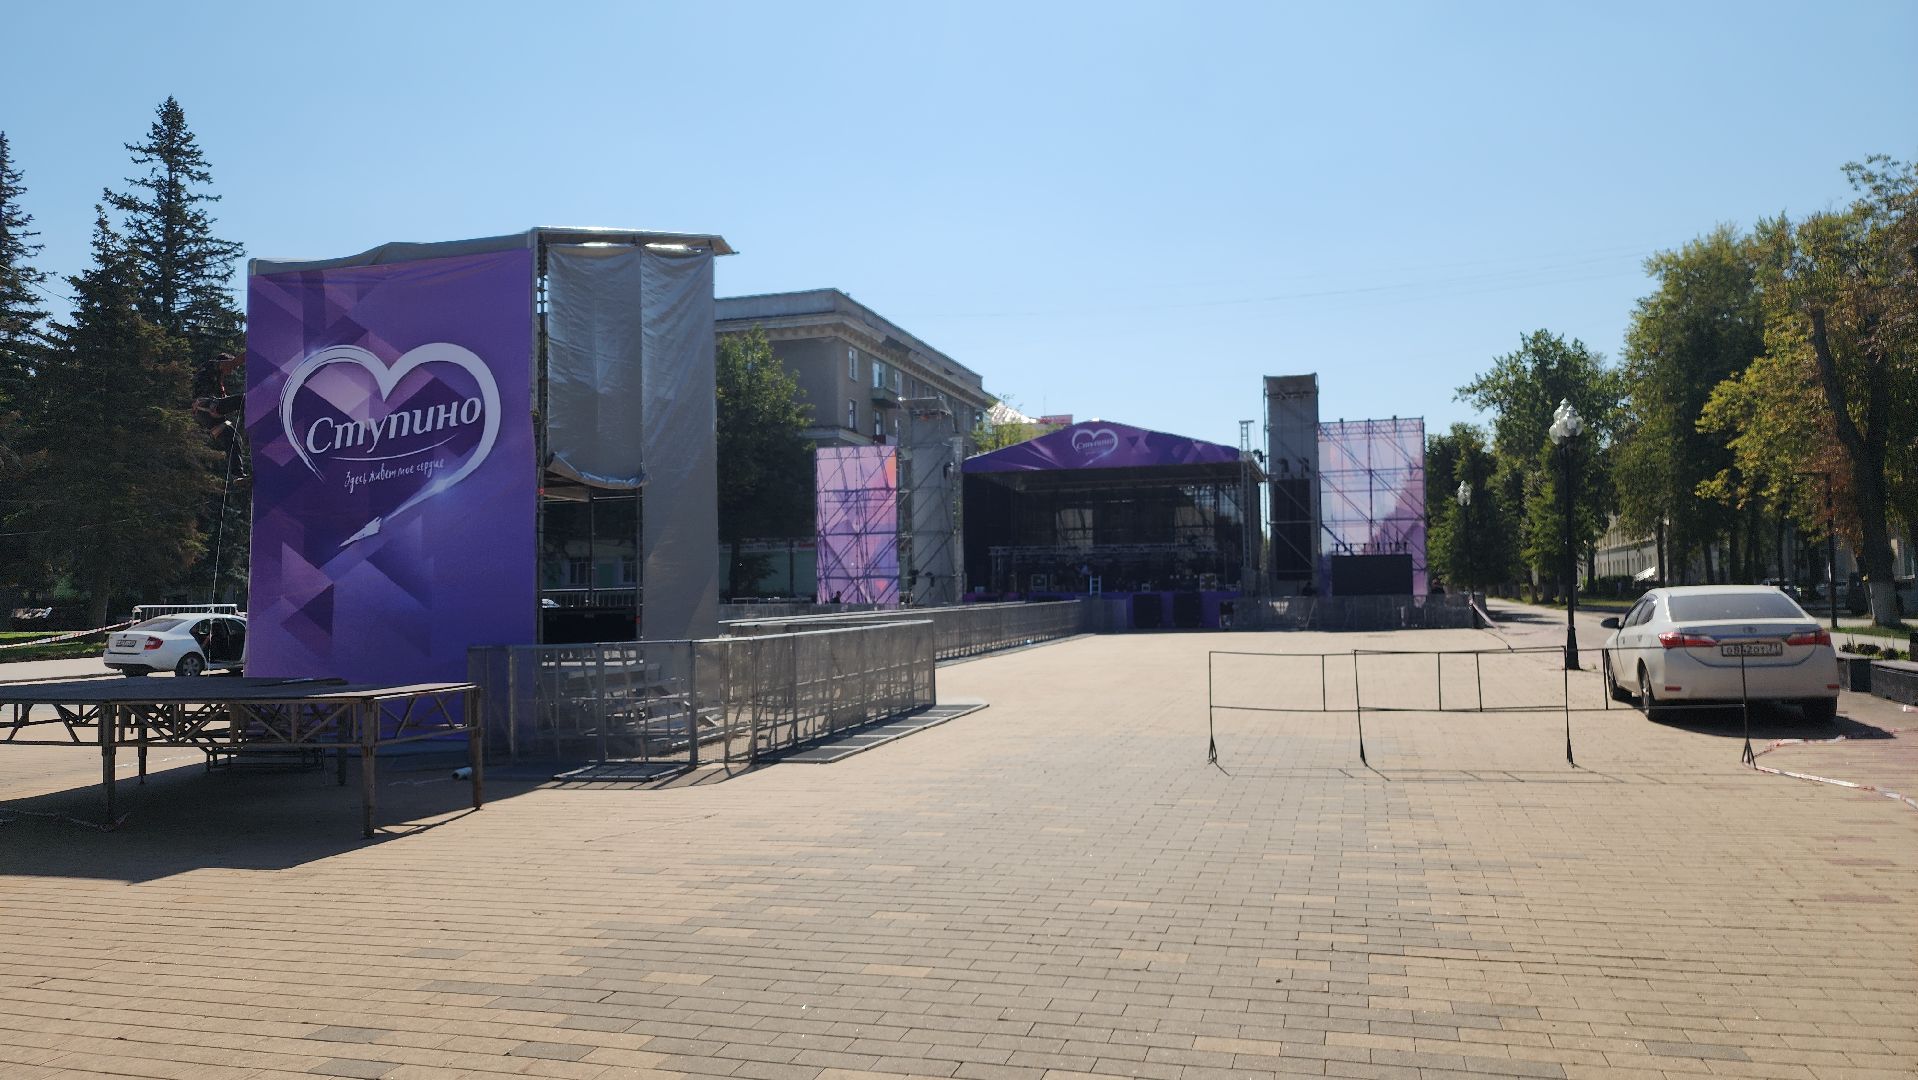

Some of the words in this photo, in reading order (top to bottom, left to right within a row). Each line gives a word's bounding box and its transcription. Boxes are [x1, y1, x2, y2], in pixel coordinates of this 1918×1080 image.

[306, 397, 482, 454] Ступино
[344, 470, 367, 493] Здесь
[416, 458, 445, 478] сердце
